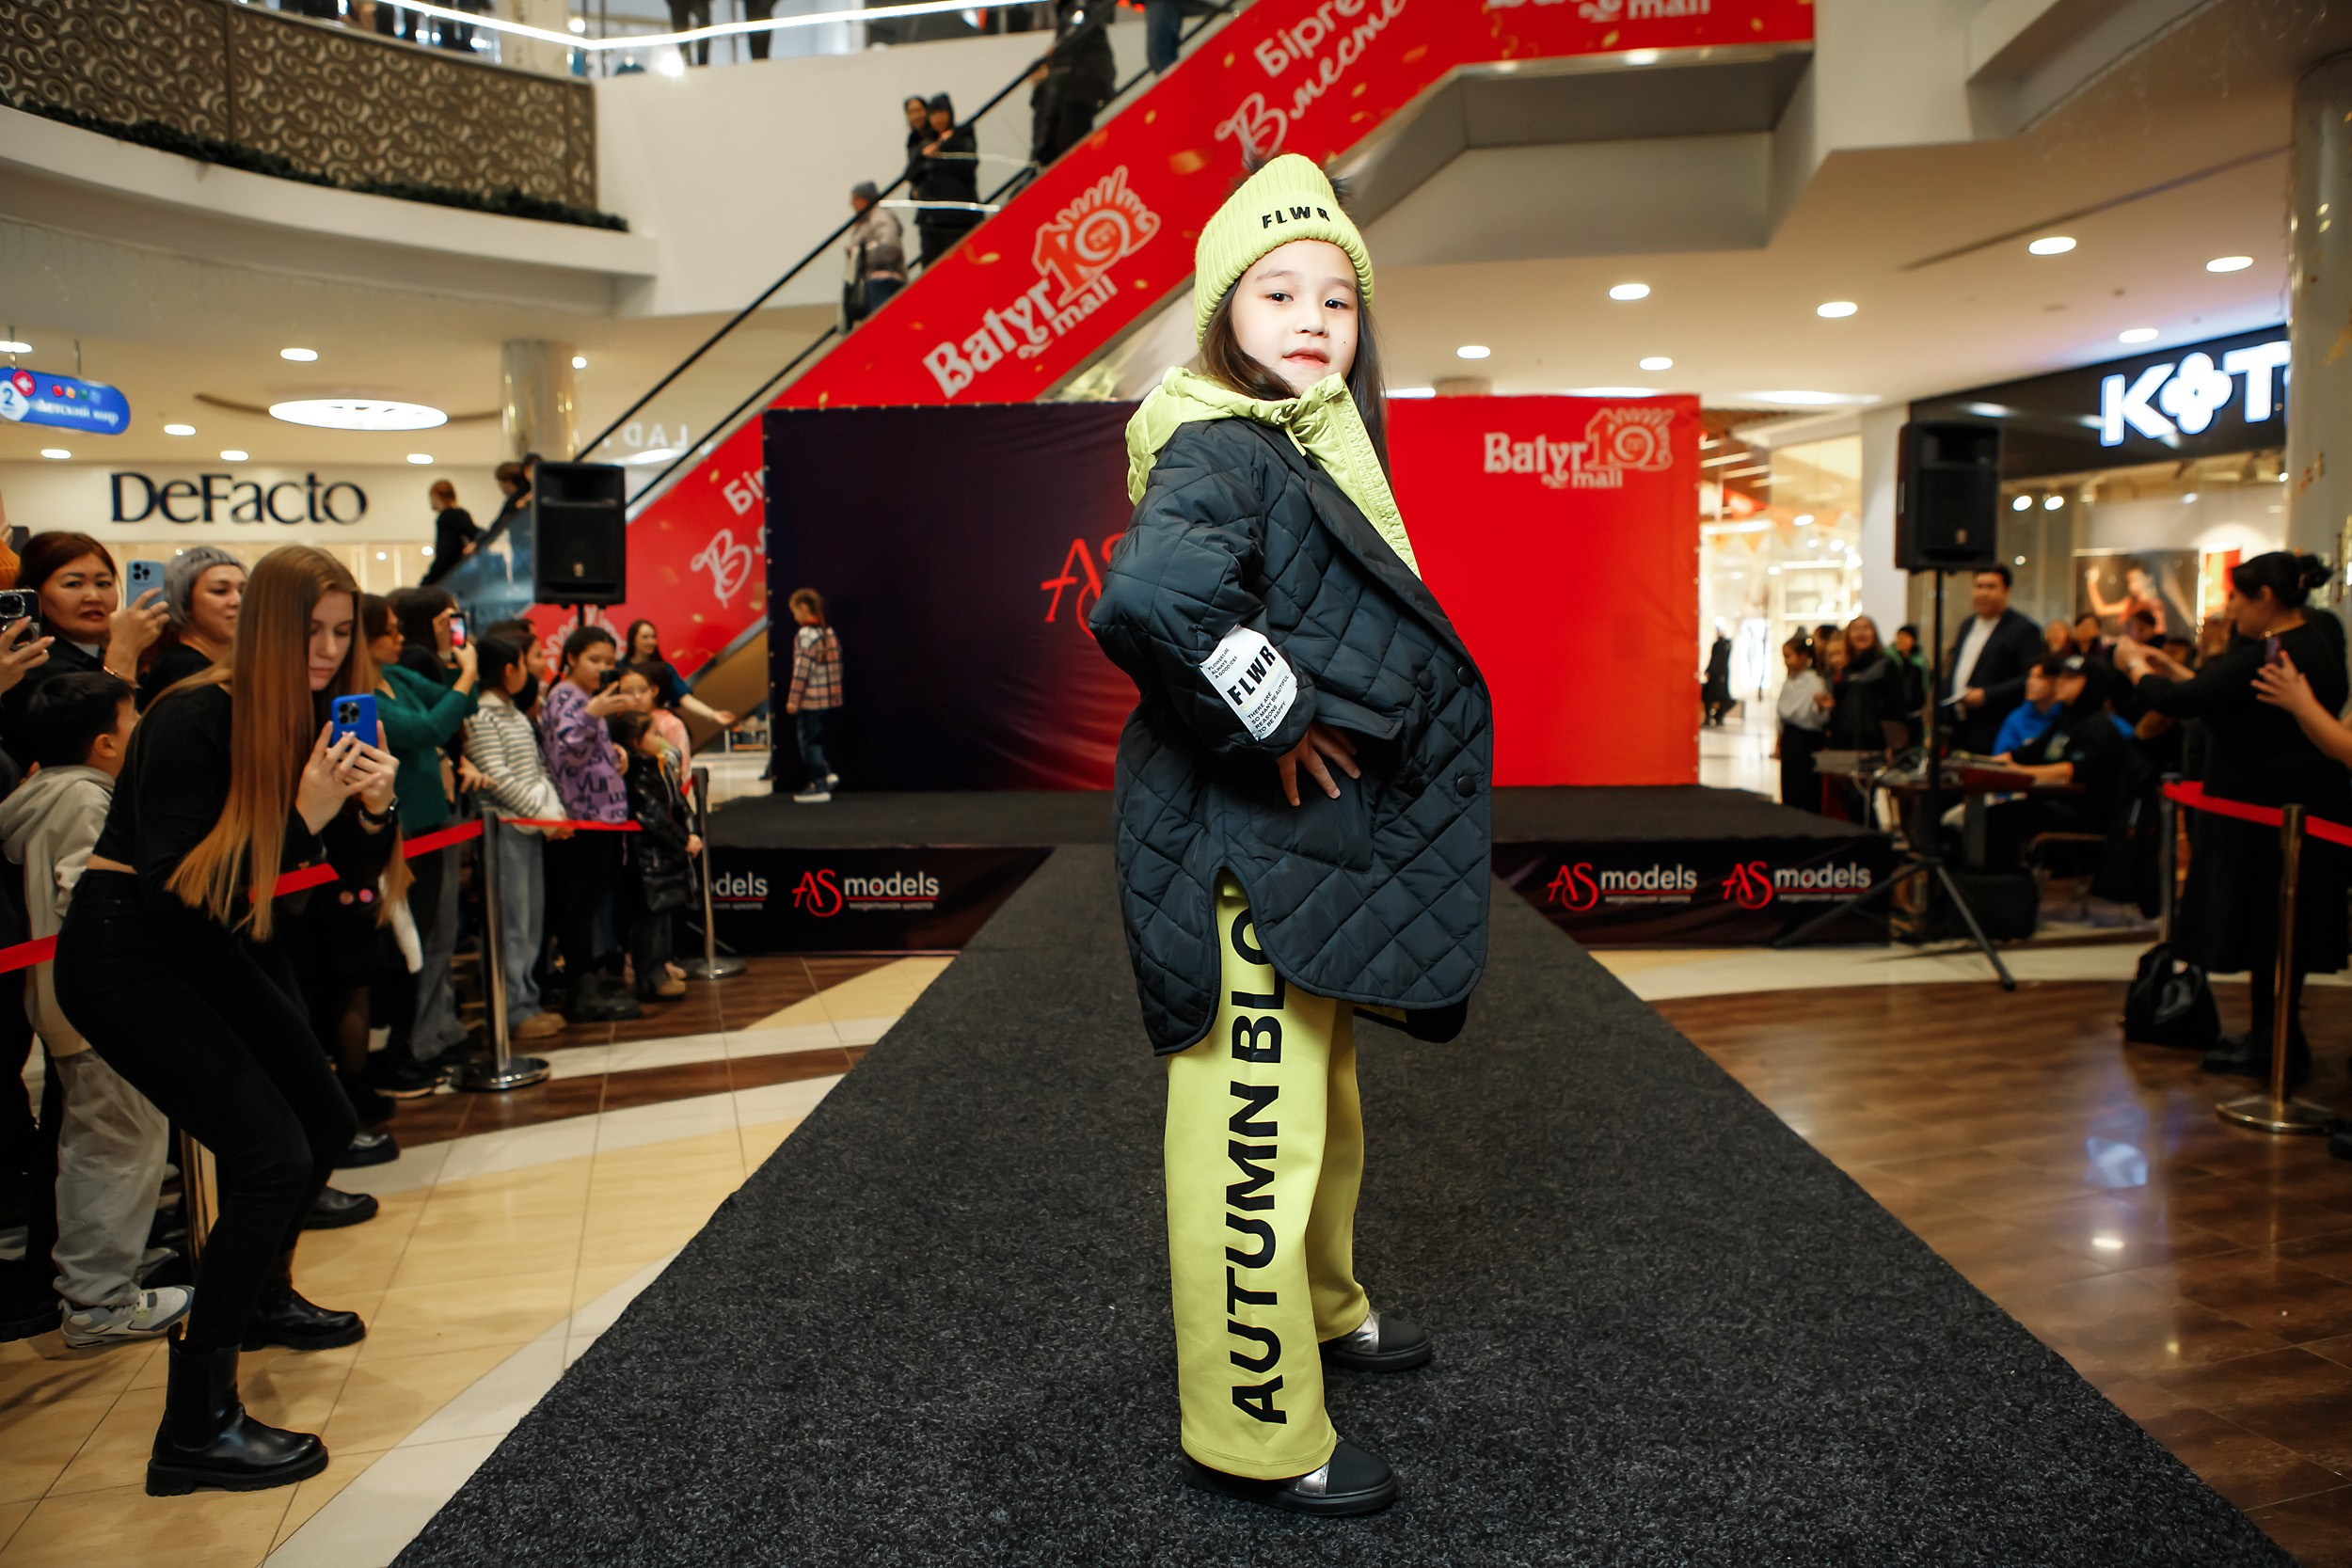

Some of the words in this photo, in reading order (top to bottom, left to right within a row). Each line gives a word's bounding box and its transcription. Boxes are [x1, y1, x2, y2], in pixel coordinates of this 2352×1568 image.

[1262, 206, 1330, 230] FLWR
[1051, 273, 1119, 337] mall
[922, 277, 1057, 399] Batyr
[1484, 432, 1588, 489] Batyr
[1571, 467, 1624, 489] mall
[110, 471, 368, 525] DeFacto
[1211, 659, 1228, 675] ALWAYS
[1227, 645, 1277, 706] FLWR
[1247, 702, 1265, 720] THERE
[1263, 690, 1273, 705] ARE
[1251, 716, 1261, 725] SO
[1259, 702, 1273, 718] MANY
[1270, 674, 1290, 703] BEAUTIFUL
[1254, 705, 1278, 730] REASONS
[1266, 718, 1275, 727] BE
[1273, 700, 1287, 720] HAPPY
[792, 868, 842, 917] AS
[844, 871, 940, 896] models
[1547, 862, 1598, 911] AS
[1600, 863, 1697, 891] models
[1722, 861, 1772, 911] AS
[1774, 862, 1872, 890] models
[1226, 1080, 1287, 1425] AUTUMN
